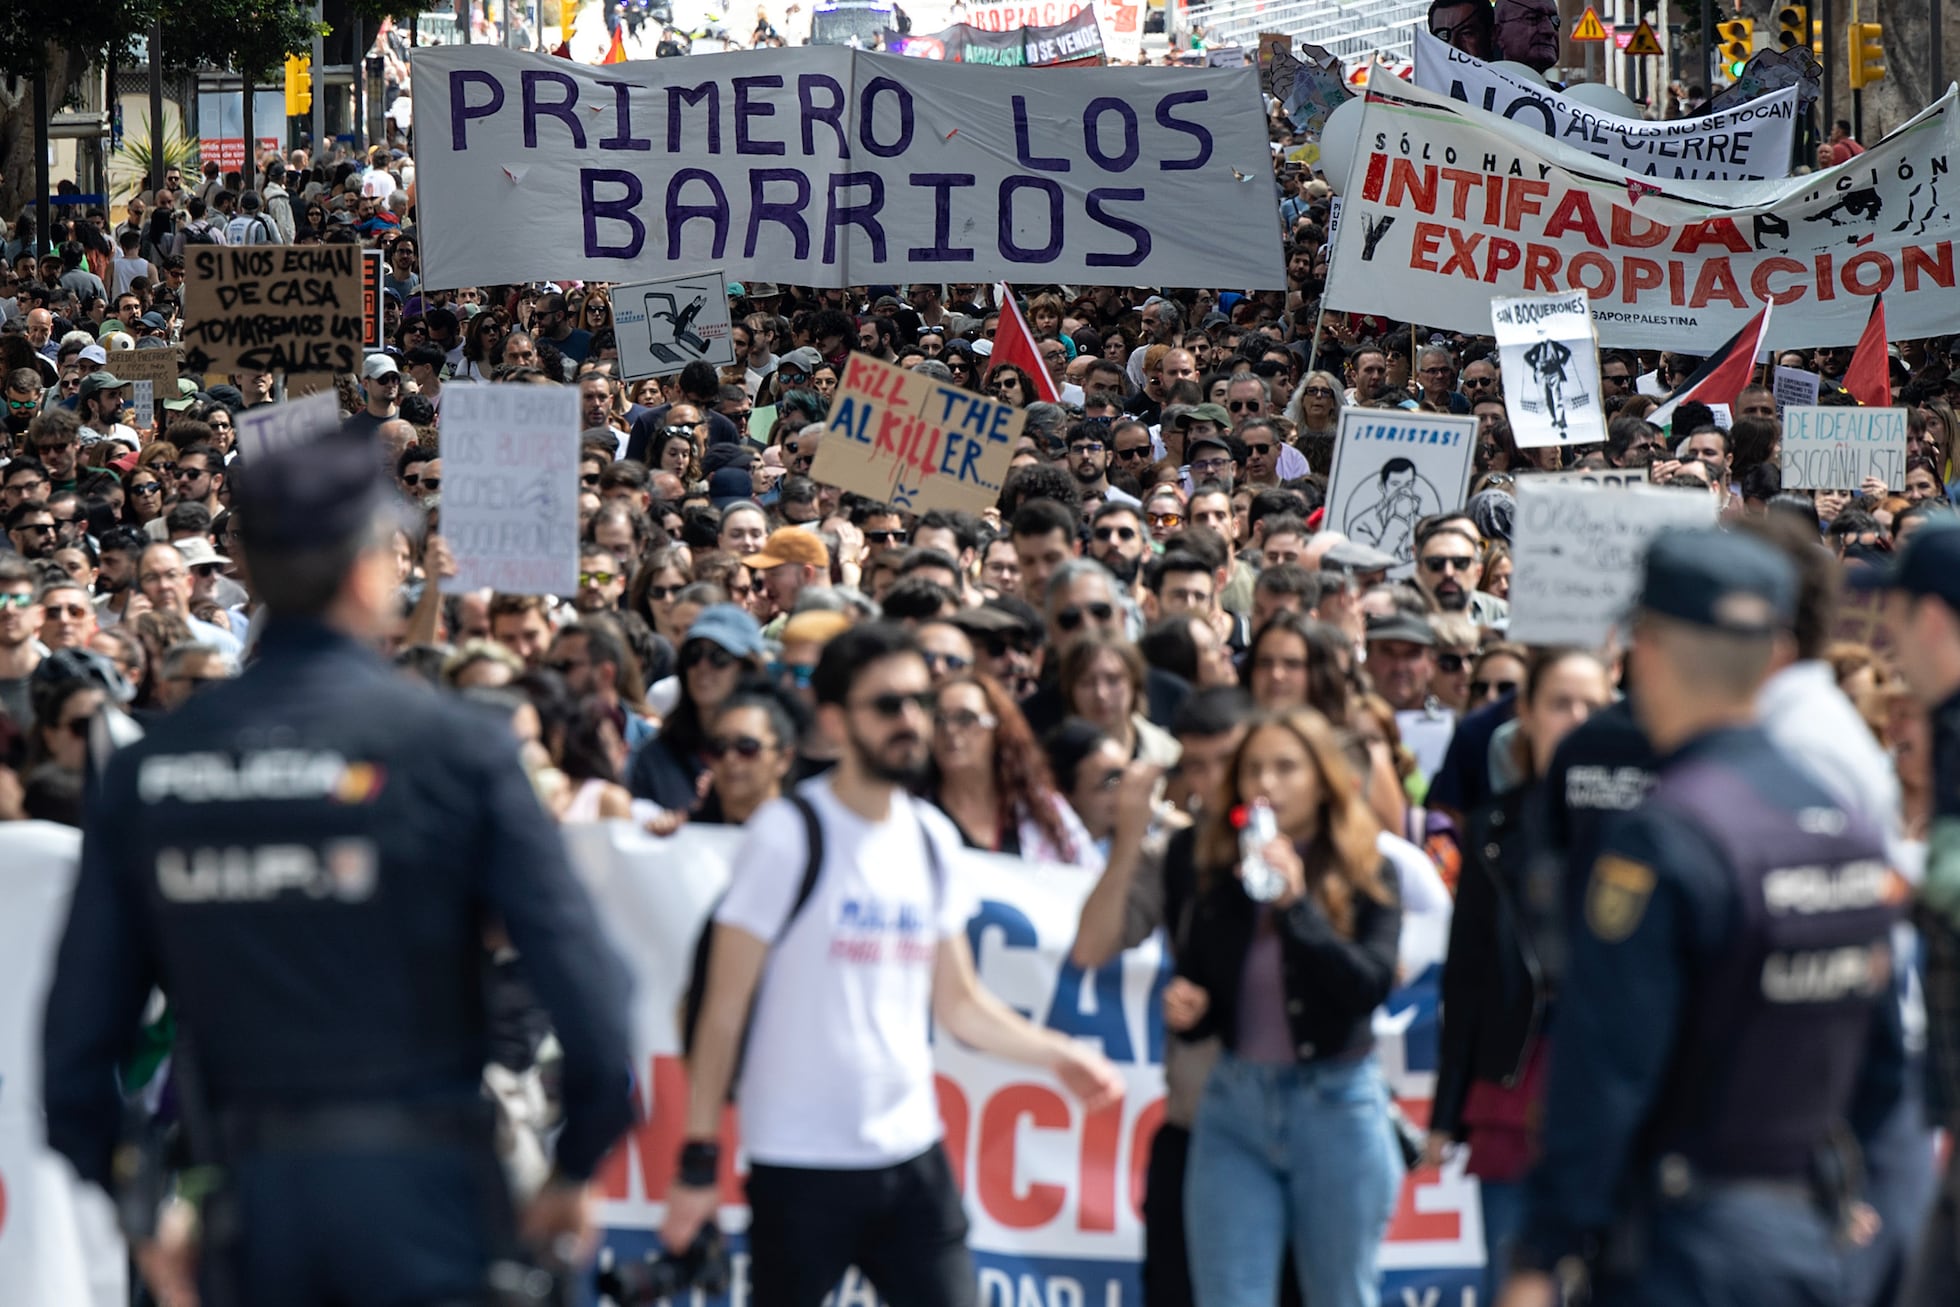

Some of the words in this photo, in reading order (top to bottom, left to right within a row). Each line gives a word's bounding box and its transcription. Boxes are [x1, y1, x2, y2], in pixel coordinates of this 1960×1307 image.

[1039, 38, 1058, 61] SE
[1056, 23, 1101, 55] VENDE
[449, 69, 915, 159] PRIMERO
[1011, 89, 1213, 173] LOS
[1668, 122, 1696, 136] NO
[1702, 116, 1724, 131] SE
[1730, 100, 1793, 126] TOCAN
[1374, 132, 1457, 165] SÓLO
[1482, 153, 1552, 180] HAY
[580, 167, 1152, 267] BARRIOS
[1362, 151, 1753, 253] INTIFADA
[196, 252, 224, 281] SI
[232, 250, 273, 278] NOS
[283, 250, 353, 278] ECHAN
[1360, 211, 1396, 262] Y
[1409, 222, 1956, 309] EXPROPIACIÓN
[217, 284, 262, 310] DE
[267, 280, 340, 309] CASA
[1496, 309, 1514, 325] SIN
[1514, 297, 1585, 325] BOQUERONES
[1592, 309, 1698, 327] GAPORPALESTINA
[937, 387, 1014, 443] THE
[1787, 412, 1809, 440] DE
[1816, 412, 1904, 441] IDEALISTA
[1355, 425, 1460, 447] ¡TURISTAS!
